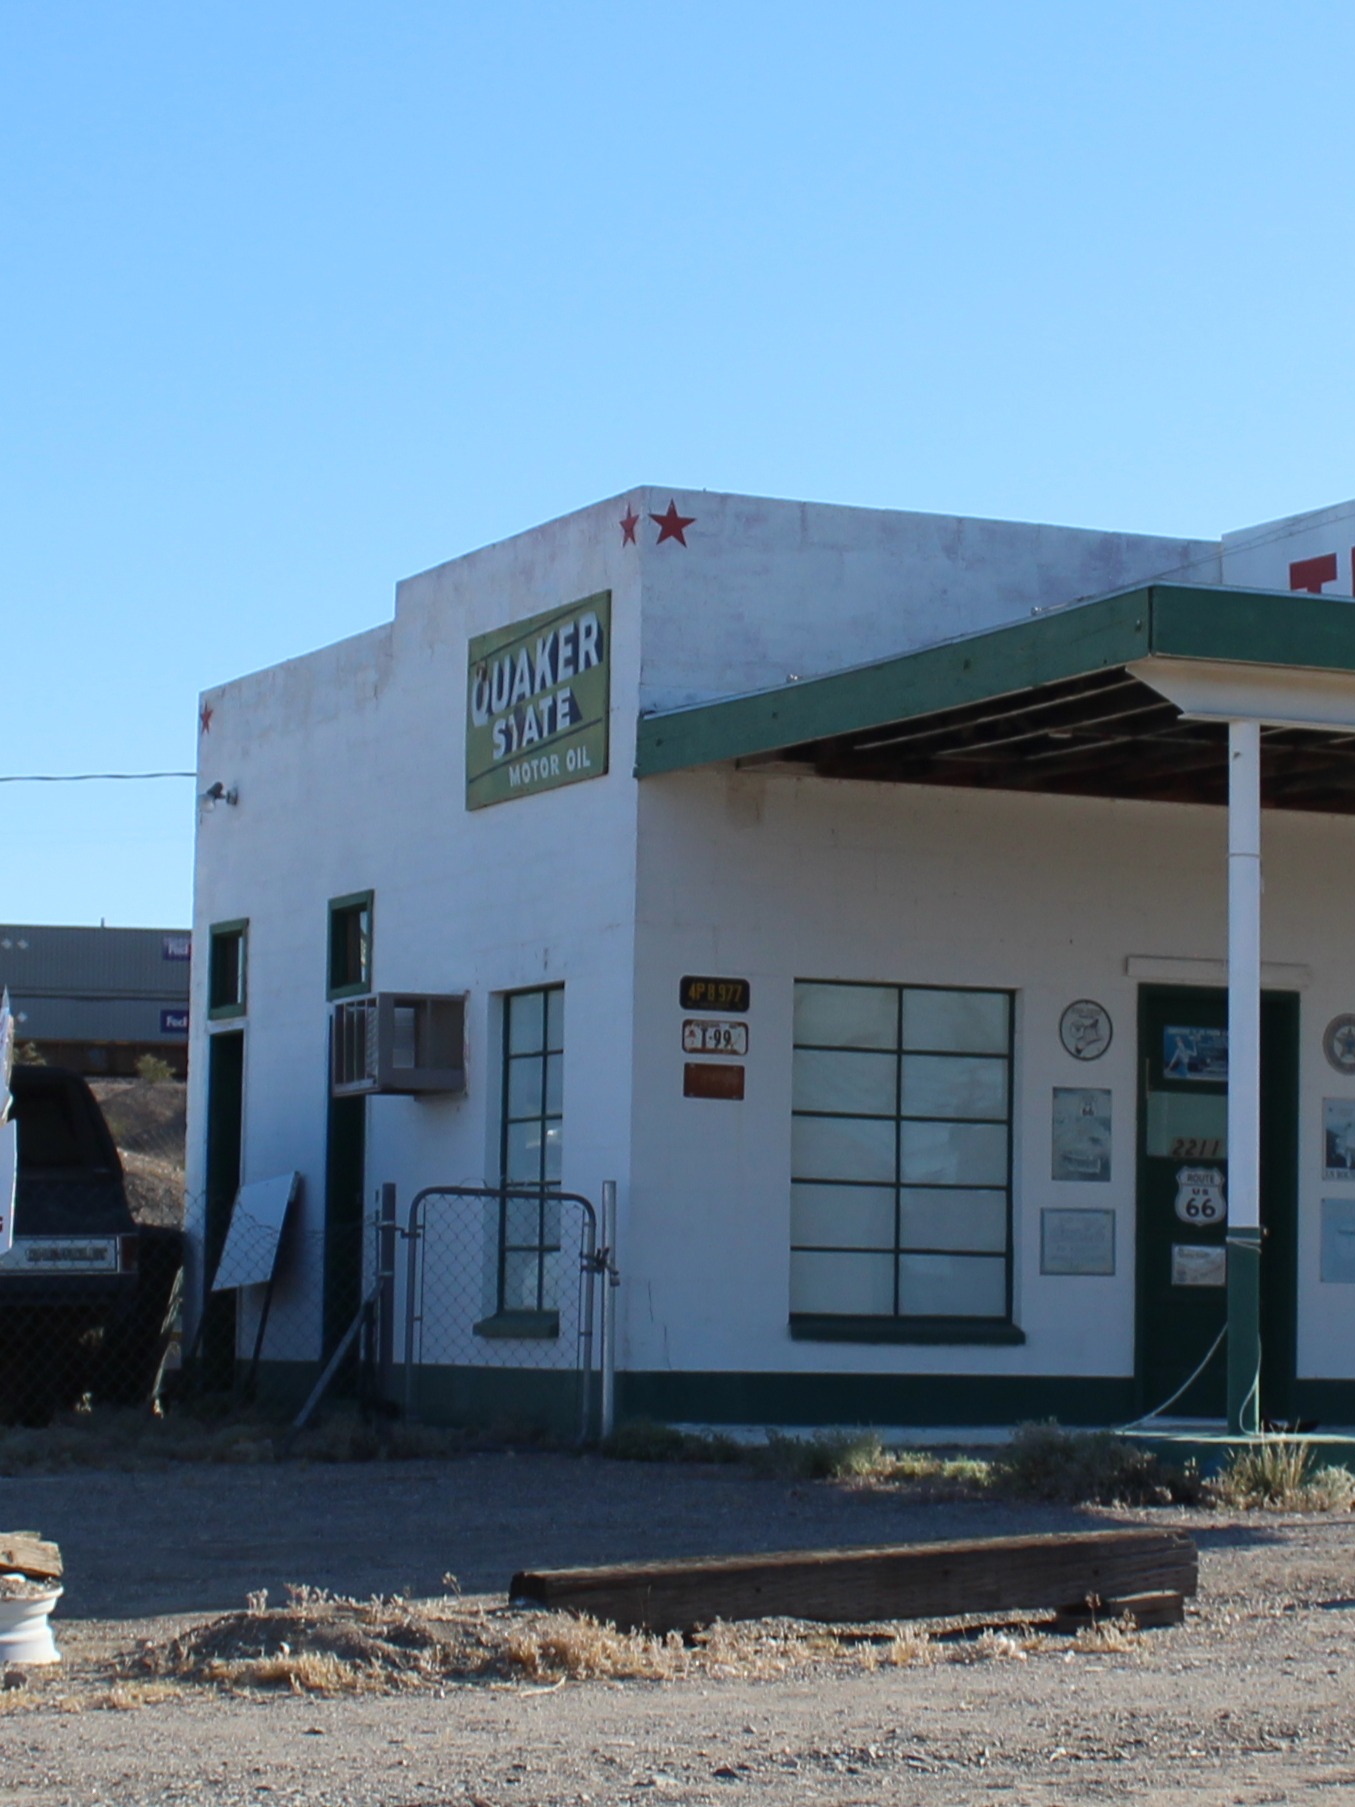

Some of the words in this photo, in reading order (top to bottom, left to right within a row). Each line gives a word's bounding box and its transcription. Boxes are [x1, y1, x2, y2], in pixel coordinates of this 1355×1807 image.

[471, 611, 601, 728] QUAKER
[492, 686, 572, 761] STATE
[508, 753, 560, 788] MOTOR
[566, 745, 591, 773] OIL
[1172, 1138, 1220, 1158] 2211
[1187, 1172, 1215, 1184] ROUTE
[1185, 1197, 1216, 1218] 66
